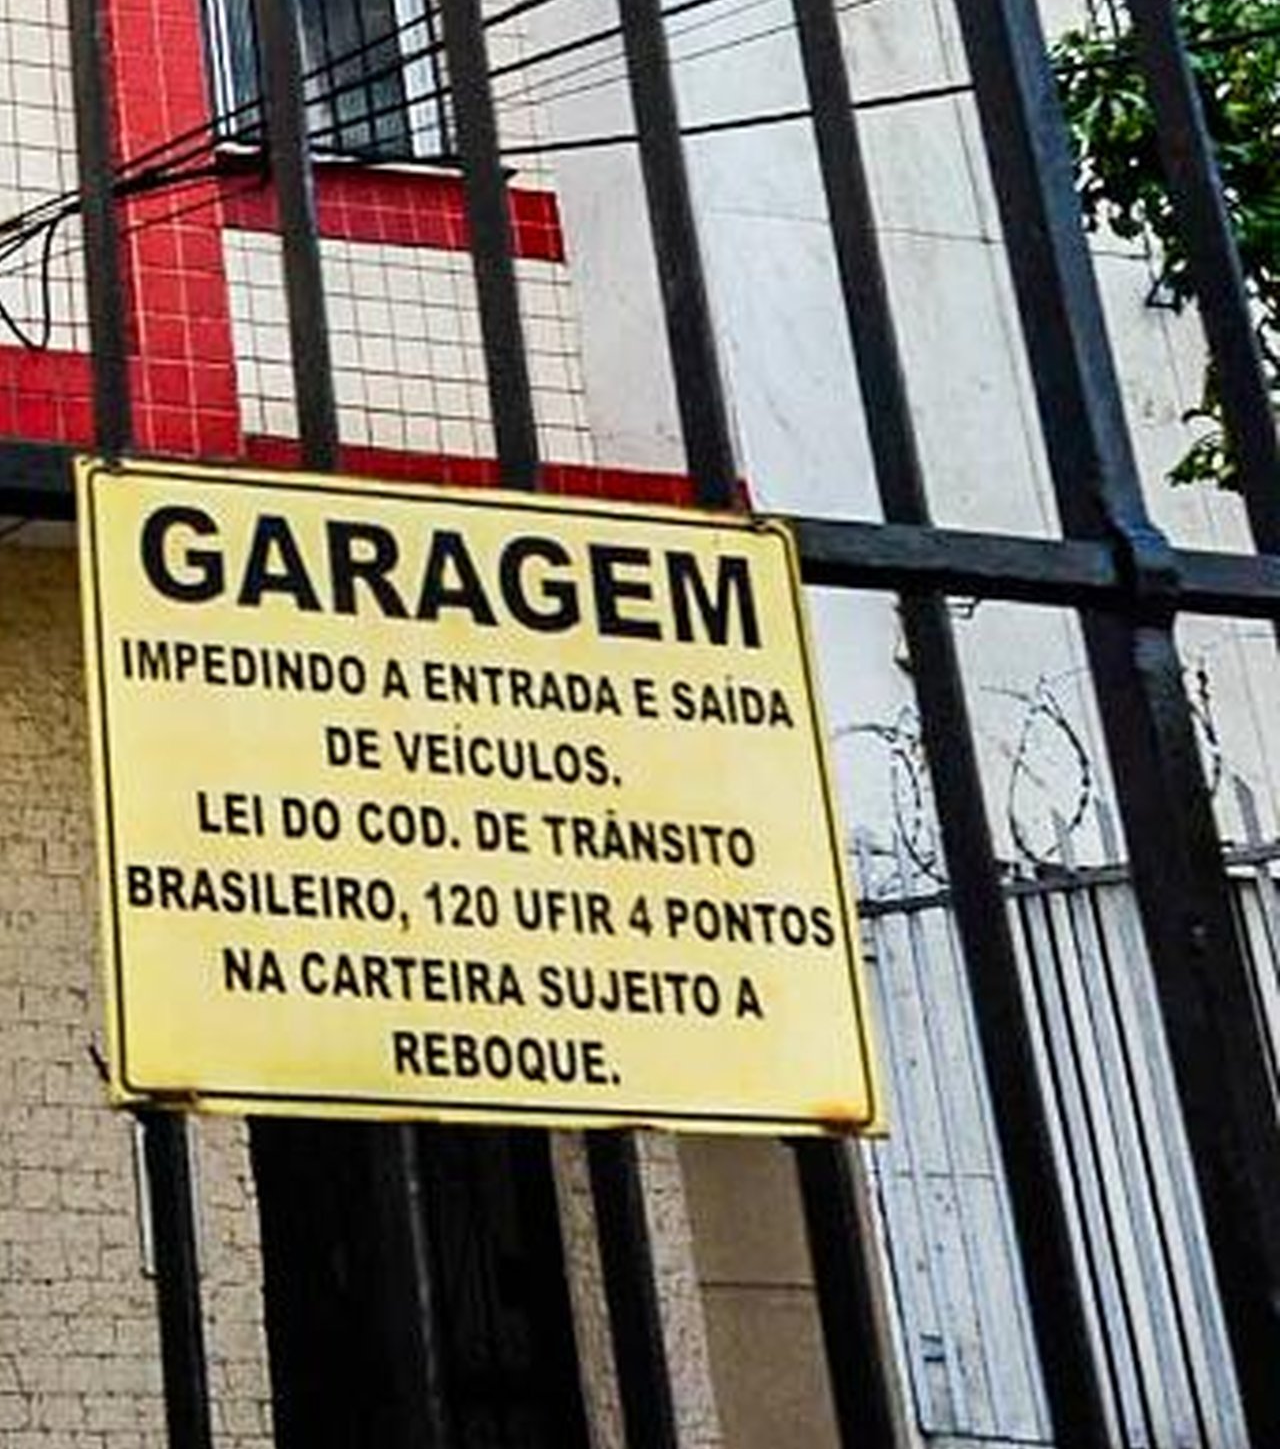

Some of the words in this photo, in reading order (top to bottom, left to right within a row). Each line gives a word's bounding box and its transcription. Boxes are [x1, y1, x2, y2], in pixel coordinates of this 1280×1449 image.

[140, 505, 761, 649] GARAGEM
[122, 638, 366, 695] IMPEDINDO
[383, 659, 410, 699] A
[423, 661, 622, 716] ENTRADA
[633, 678, 659, 719] E
[672, 674, 794, 728] SAÍDA
[326, 726, 381, 770] DE
[393, 723, 621, 787] VEÍCULOS.
[197, 791, 265, 837] LEI
[281, 797, 341, 841] DO
[358, 802, 460, 849] COD.
[475, 810, 530, 853] DE
[542, 807, 755, 868] TRÂNSITO
[127, 865, 409, 930] BRASILEIRO,
[425, 882, 499, 928] 120
[514, 888, 615, 936] UFIR
[629, 896, 653, 937] 4
[665, 898, 835, 947] PONTOS
[222, 948, 287, 994] NA
[300, 951, 525, 1006] CARTEIRA
[539, 966, 720, 1017] SUJEITO
[736, 977, 763, 1018] A
[393, 1031, 621, 1085] REBOQUE.
